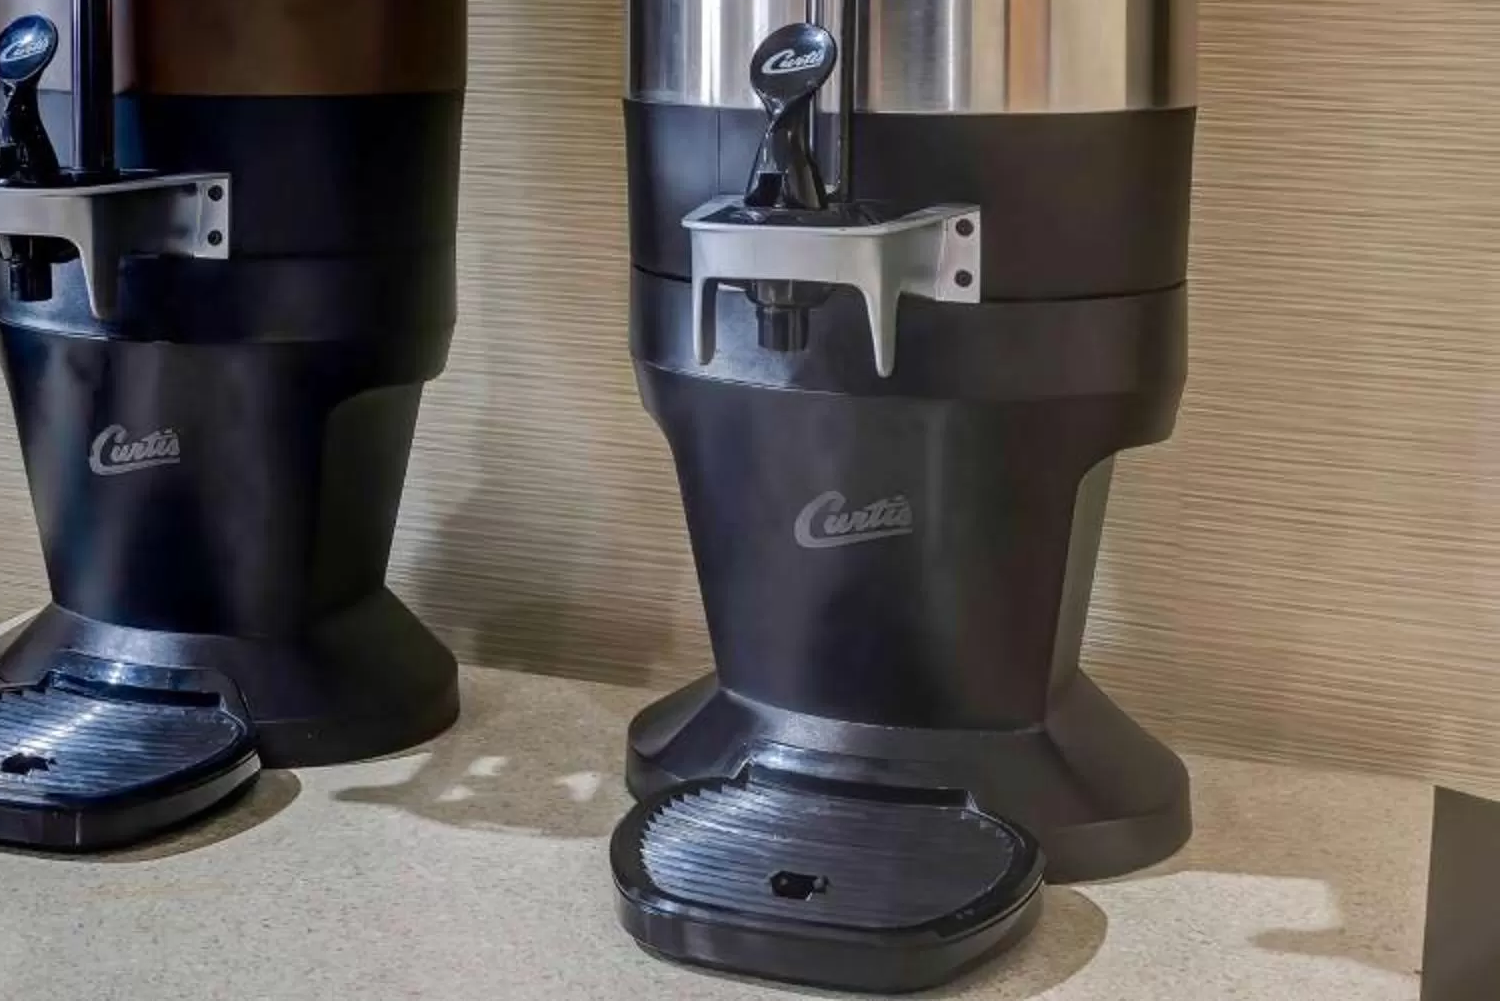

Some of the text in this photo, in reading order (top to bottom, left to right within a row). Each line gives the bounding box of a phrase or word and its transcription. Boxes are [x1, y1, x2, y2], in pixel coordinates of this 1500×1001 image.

[761, 47, 826, 74] Curtis
[89, 424, 181, 476] Curtis
[793, 490, 913, 549] Curtis
